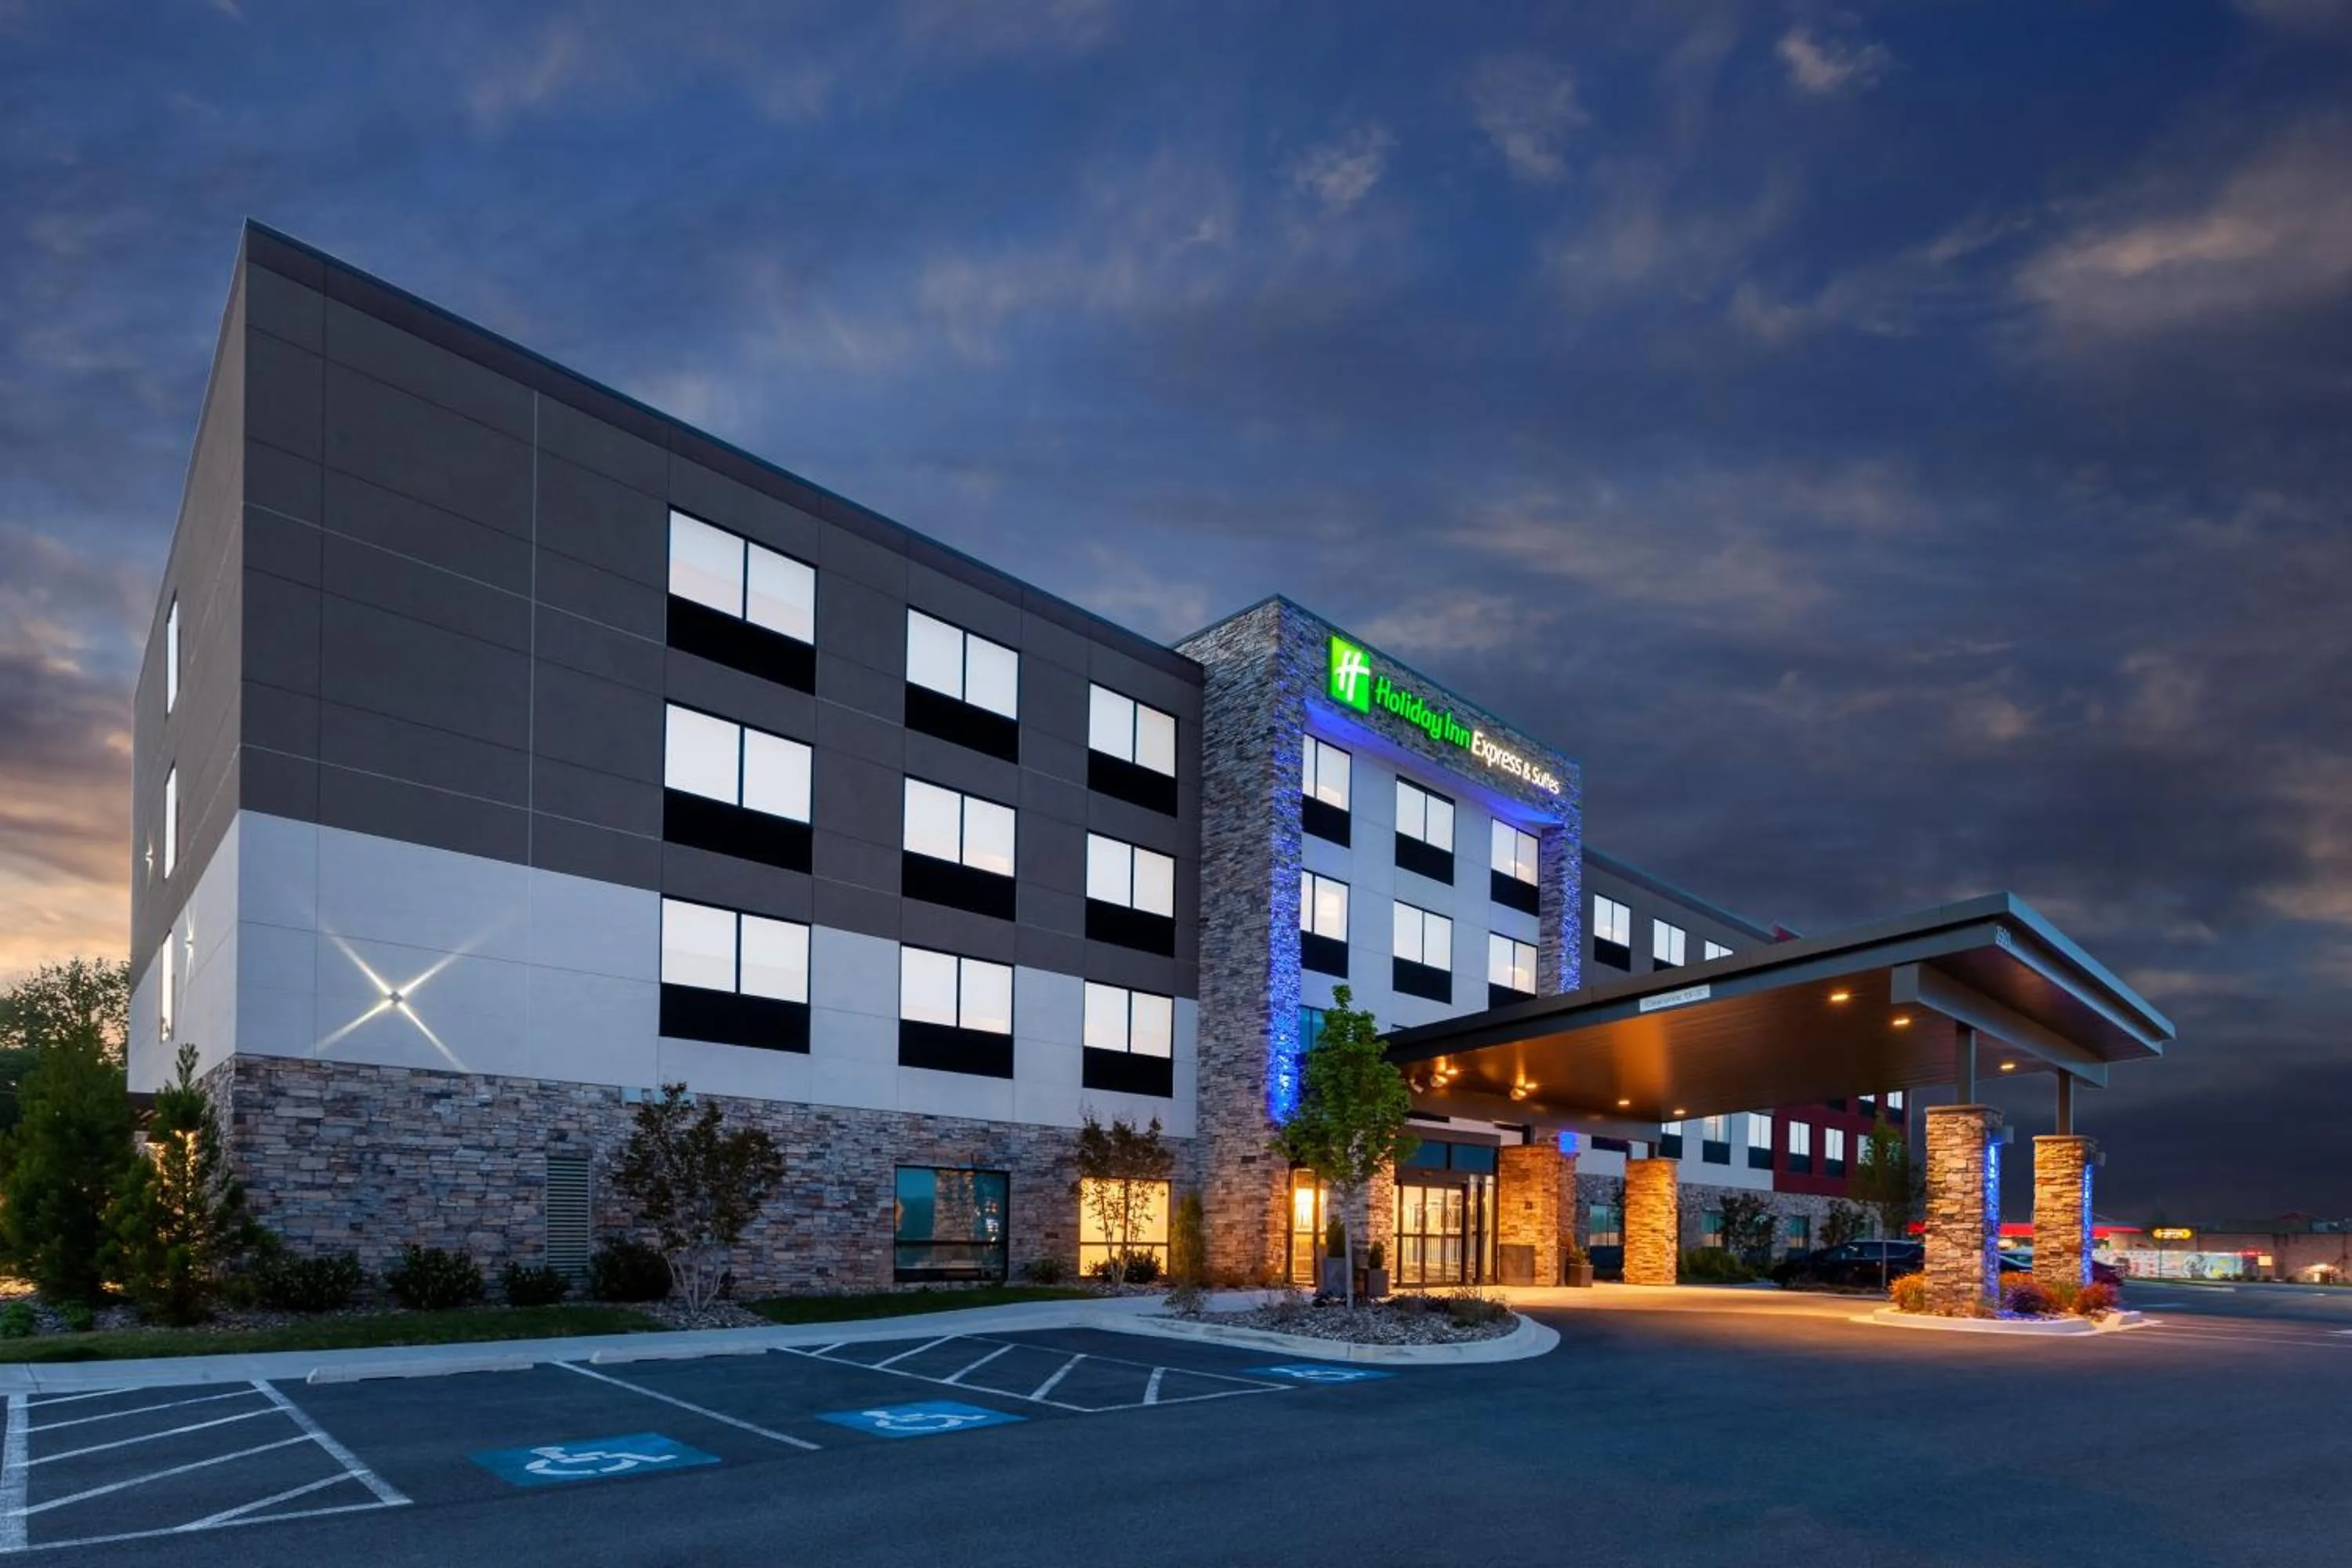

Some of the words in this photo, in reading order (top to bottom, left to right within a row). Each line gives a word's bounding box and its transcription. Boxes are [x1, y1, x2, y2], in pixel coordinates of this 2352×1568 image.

[1375, 675, 1443, 739] Holiday
[1444, 710, 1471, 750] Inn
[1472, 729, 1523, 776] Express
[1522, 762, 1531, 781] &
[1531, 766, 1560, 795] Suites
